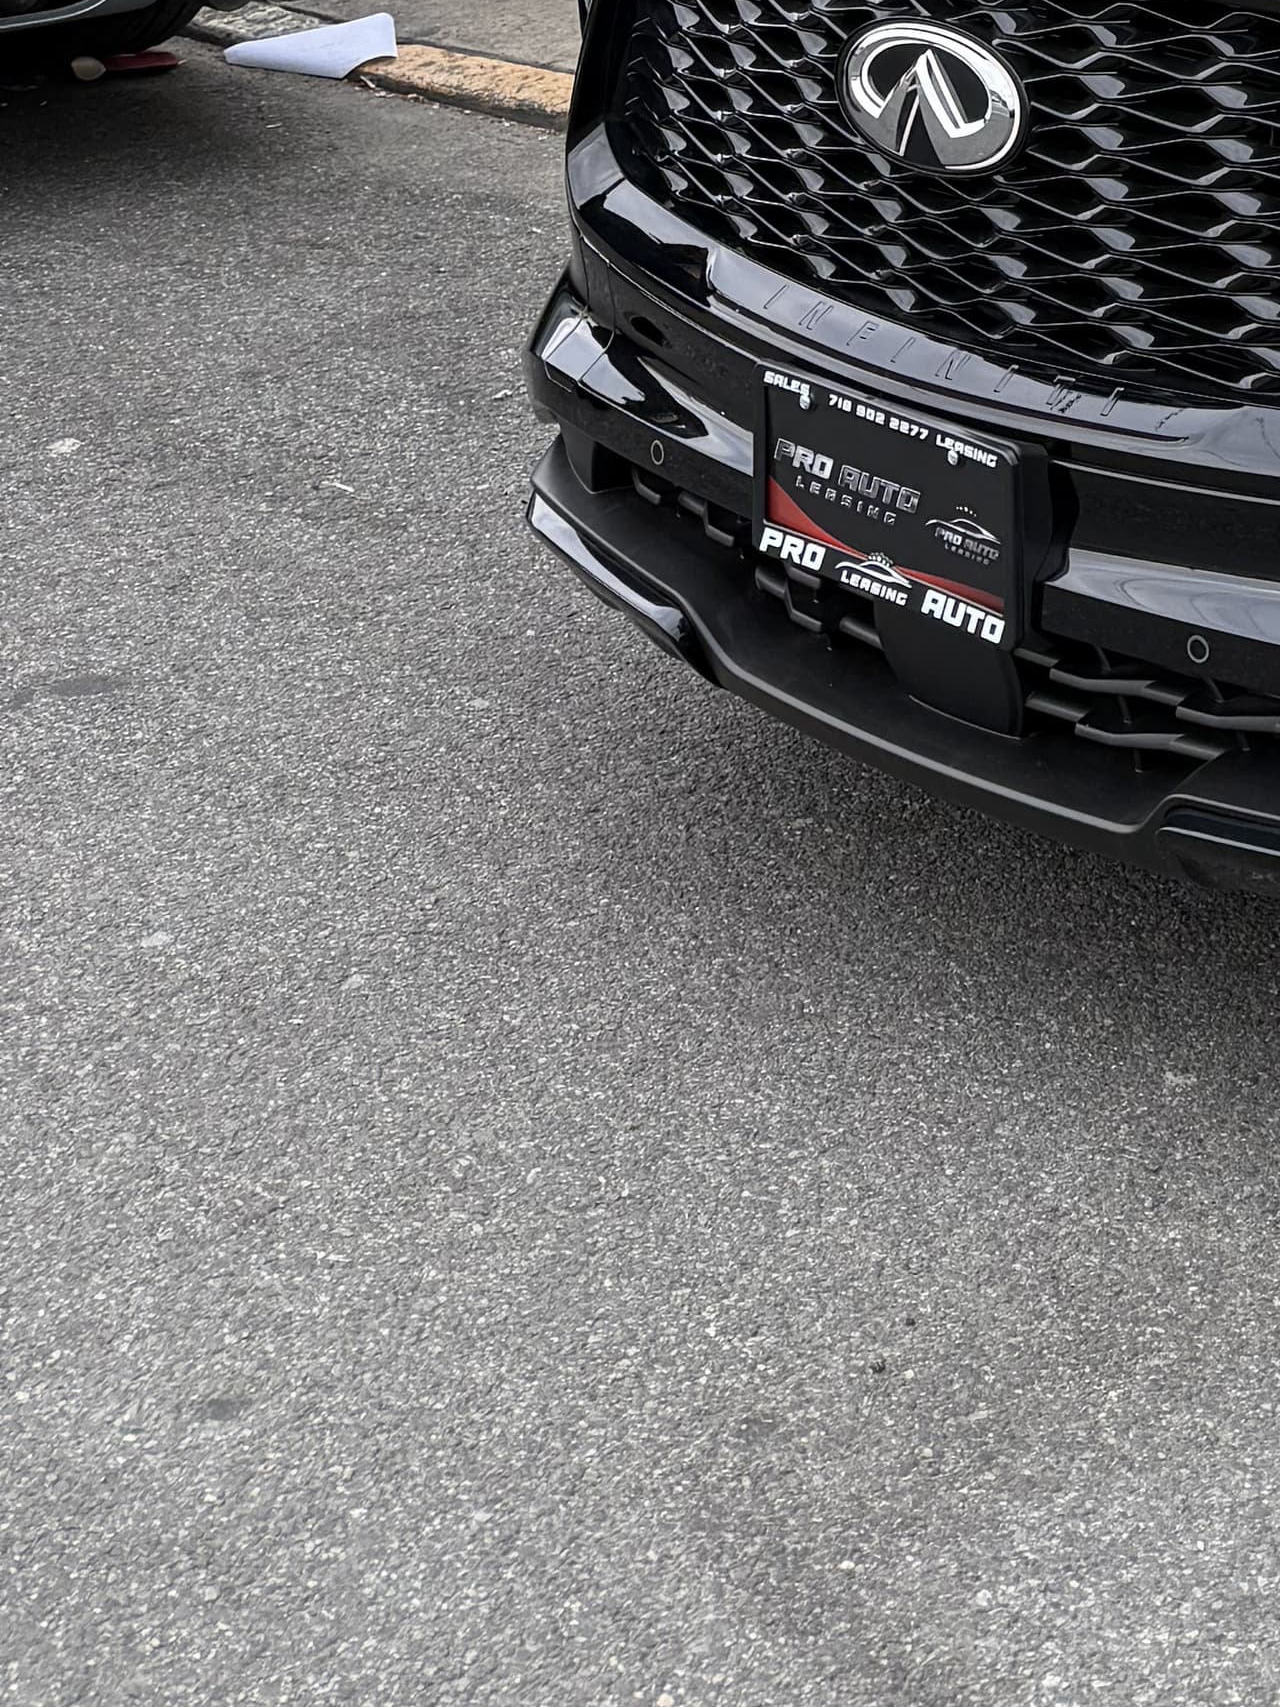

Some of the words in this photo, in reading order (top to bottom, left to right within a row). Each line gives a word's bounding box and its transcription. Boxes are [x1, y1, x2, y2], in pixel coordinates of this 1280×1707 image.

[763, 371, 811, 397] SALES
[828, 394, 852, 413] 718
[856, 405, 886, 425] 902
[889, 417, 929, 441] 2277
[935, 434, 998, 469] LEASING
[774, 438, 834, 481] PRO
[838, 464, 921, 515] AUTO
[795, 475, 898, 525] LEASING
[758, 525, 826, 573] PRO
[934, 526, 961, 547] PRO
[962, 535, 1000, 559] AUTO
[839, 568, 909, 607] LEASING
[920, 588, 1006, 645] AUTO
